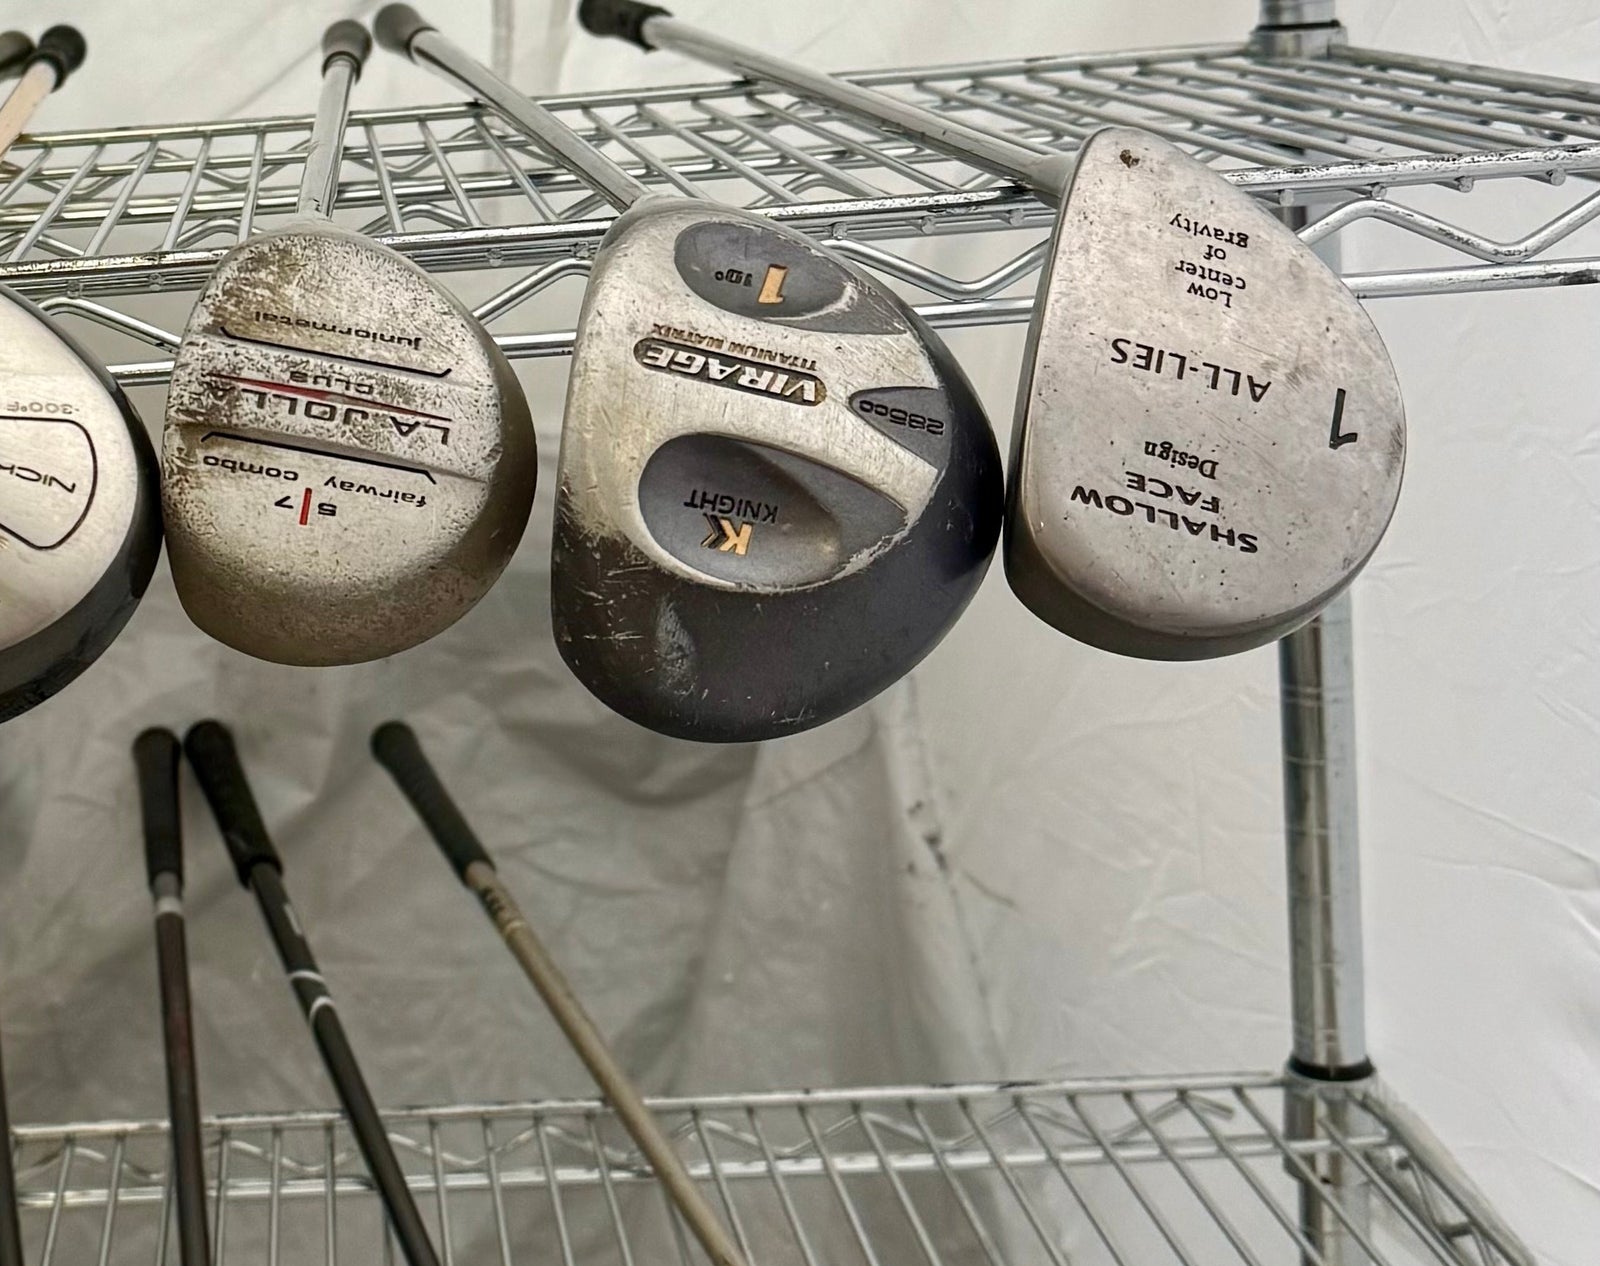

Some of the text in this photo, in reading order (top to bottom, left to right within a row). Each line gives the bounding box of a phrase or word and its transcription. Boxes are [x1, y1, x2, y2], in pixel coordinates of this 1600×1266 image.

[1168, 211, 1250, 249] gravity
[1202, 245, 1227, 261] of
[758, 264, 789, 304] 1
[1175, 259, 1247, 291] center
[1186, 282, 1233, 309] Low
[253, 310, 421, 352] juniormetal
[650, 321, 818, 373] TITANIUM MATRIX
[641, 347, 820, 404] VIRAGE
[1109, 337, 1272, 403] ALL-LIES
[388, 416, 451, 446] LA
[858, 397, 946, 437] 285cc
[1328, 388, 1358, 450] 1
[1143, 440, 1220, 481] Design
[201, 454, 428, 509] fairway combo
[1124, 469, 1221, 514] FACE
[684, 488, 779, 524] KNIGHT
[1069, 483, 1259, 555] SHALLOW
